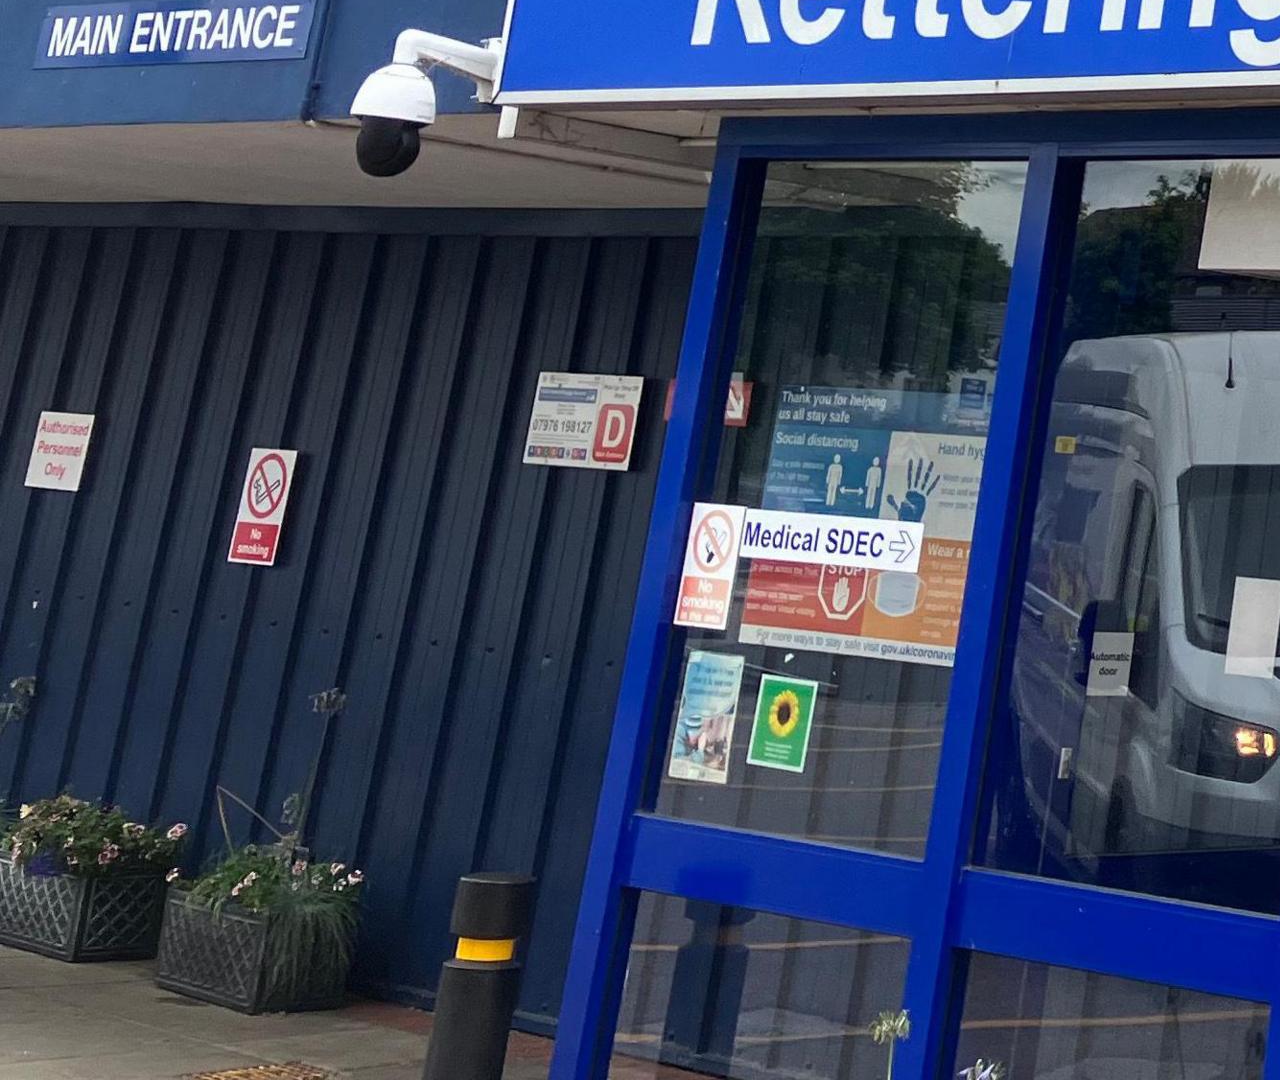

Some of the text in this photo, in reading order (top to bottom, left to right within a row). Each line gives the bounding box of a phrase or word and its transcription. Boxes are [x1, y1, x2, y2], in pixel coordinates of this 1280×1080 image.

[47, 4, 301, 58] MAIN ENTRANCE
[783, 391, 887, 411] Thank you for helping
[778, 408, 851, 425] us all stay safe
[40, 420, 91, 436] Authorised
[532, 418, 559, 432] 07976
[602, 409, 626, 448] D
[37, 440, 84, 457] Personnel
[776, 431, 860, 453] Social distancing
[938, 442, 966, 456] Hand
[45, 462, 66, 480] Only
[250, 528, 262, 540] No
[743, 521, 885, 558] Medical SDEC
[237, 544, 269, 559] smoking
[928, 542, 963, 558] Wear a
[828, 564, 862, 576] STOP
[698, 579, 713, 593] No
[682, 596, 724, 614] smoking
[756, 628, 769, 641] For
[771, 633, 793, 643] more
[794, 634, 814, 646] ways
[816, 636, 824, 646] to
[825, 637, 842, 650] stay
[844, 638, 862, 651] safe
[863, 640, 880, 652] visit
[1091, 651, 1130, 661] Automatic
[1099, 666, 1118, 676] door
